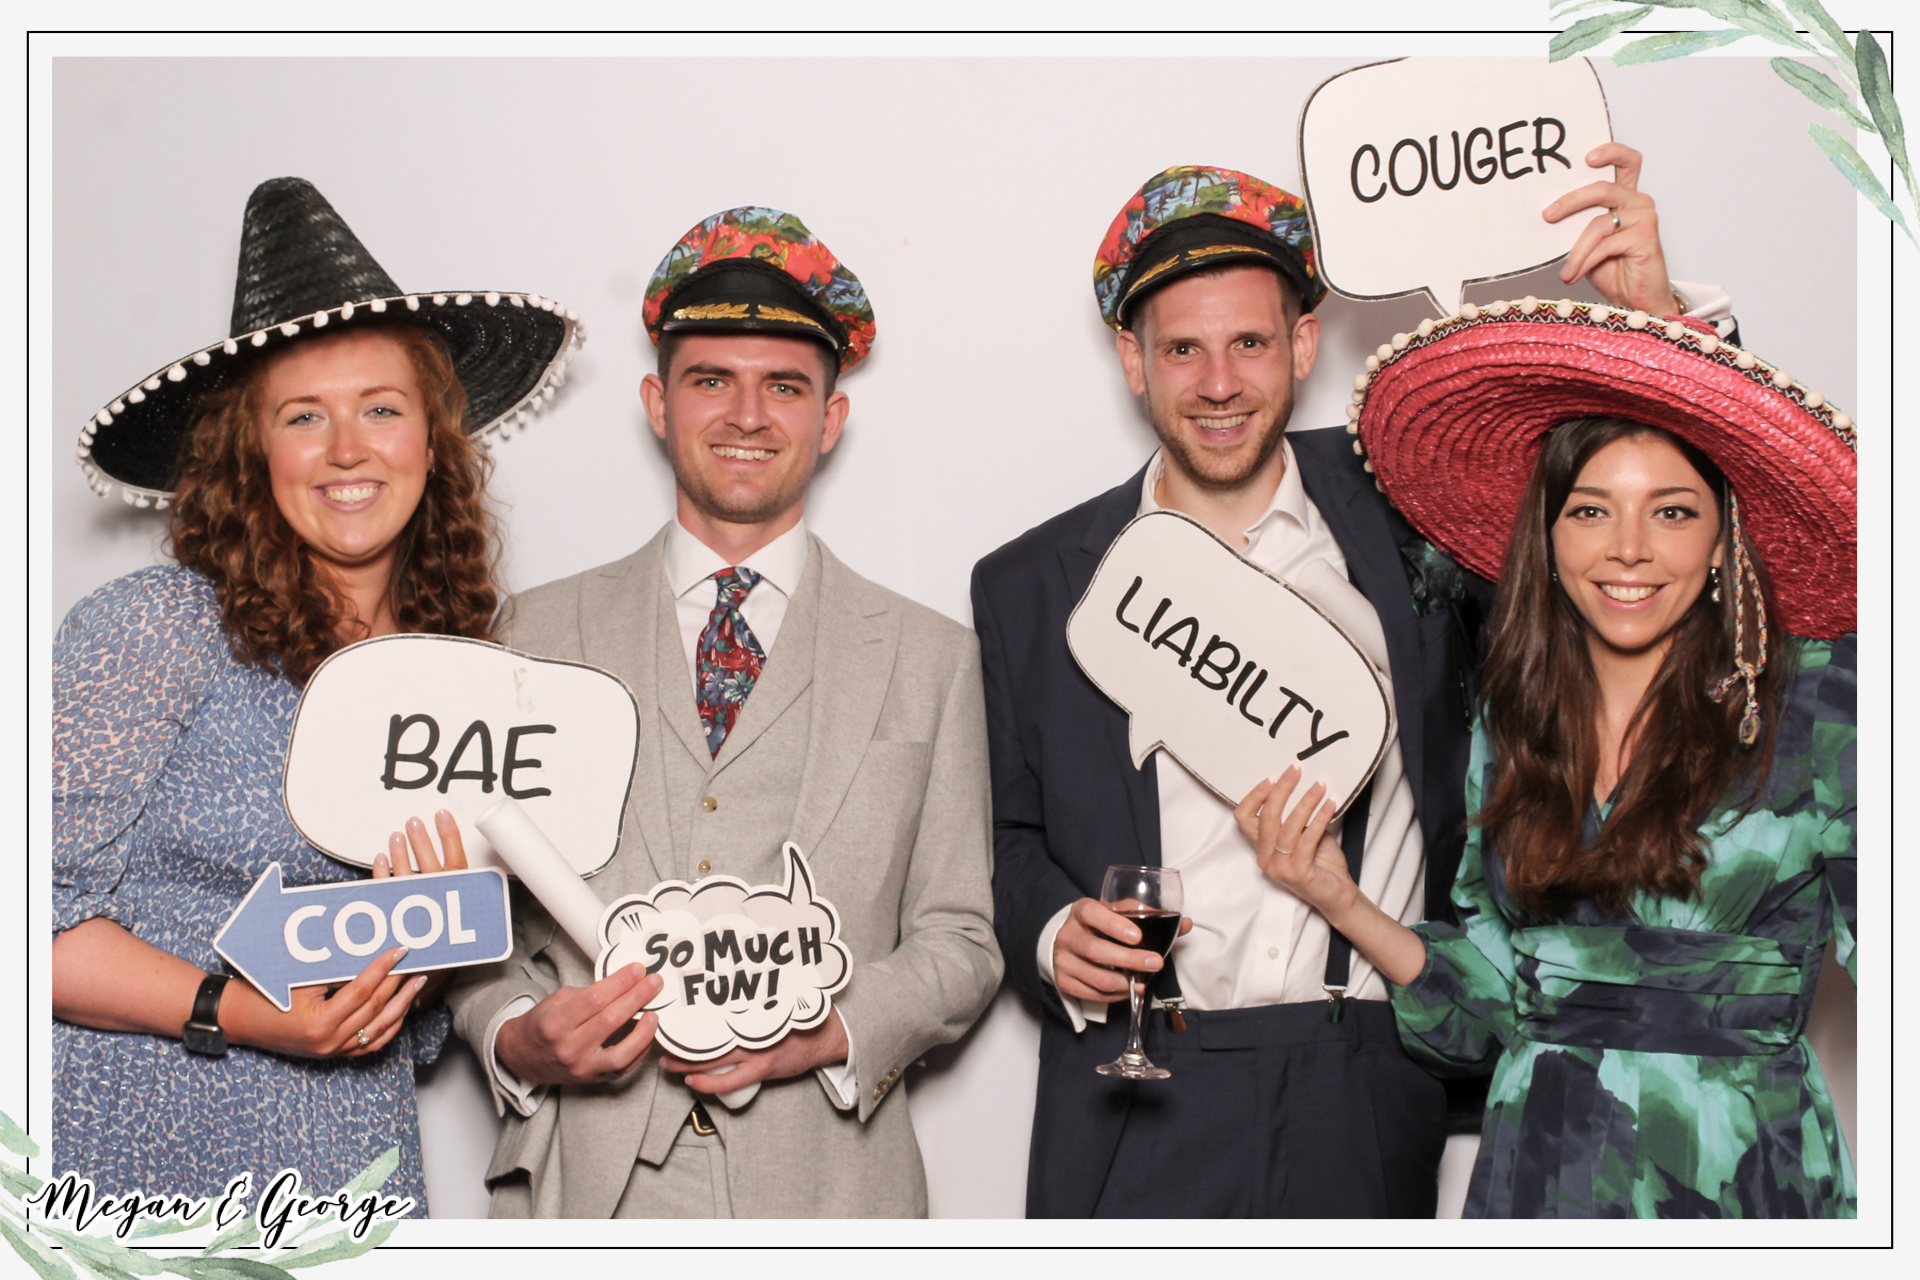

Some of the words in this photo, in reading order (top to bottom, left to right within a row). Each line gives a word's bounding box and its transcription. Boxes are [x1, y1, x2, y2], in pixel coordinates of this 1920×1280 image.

[1350, 116, 1572, 203] COUGER
[1115, 575, 1350, 762] LIABILTY
[380, 713, 557, 799] BAE
[283, 889, 477, 963] COOL
[644, 933, 694, 975] SO
[703, 926, 823, 973] MUCH
[683, 967, 781, 1010] FUN!
